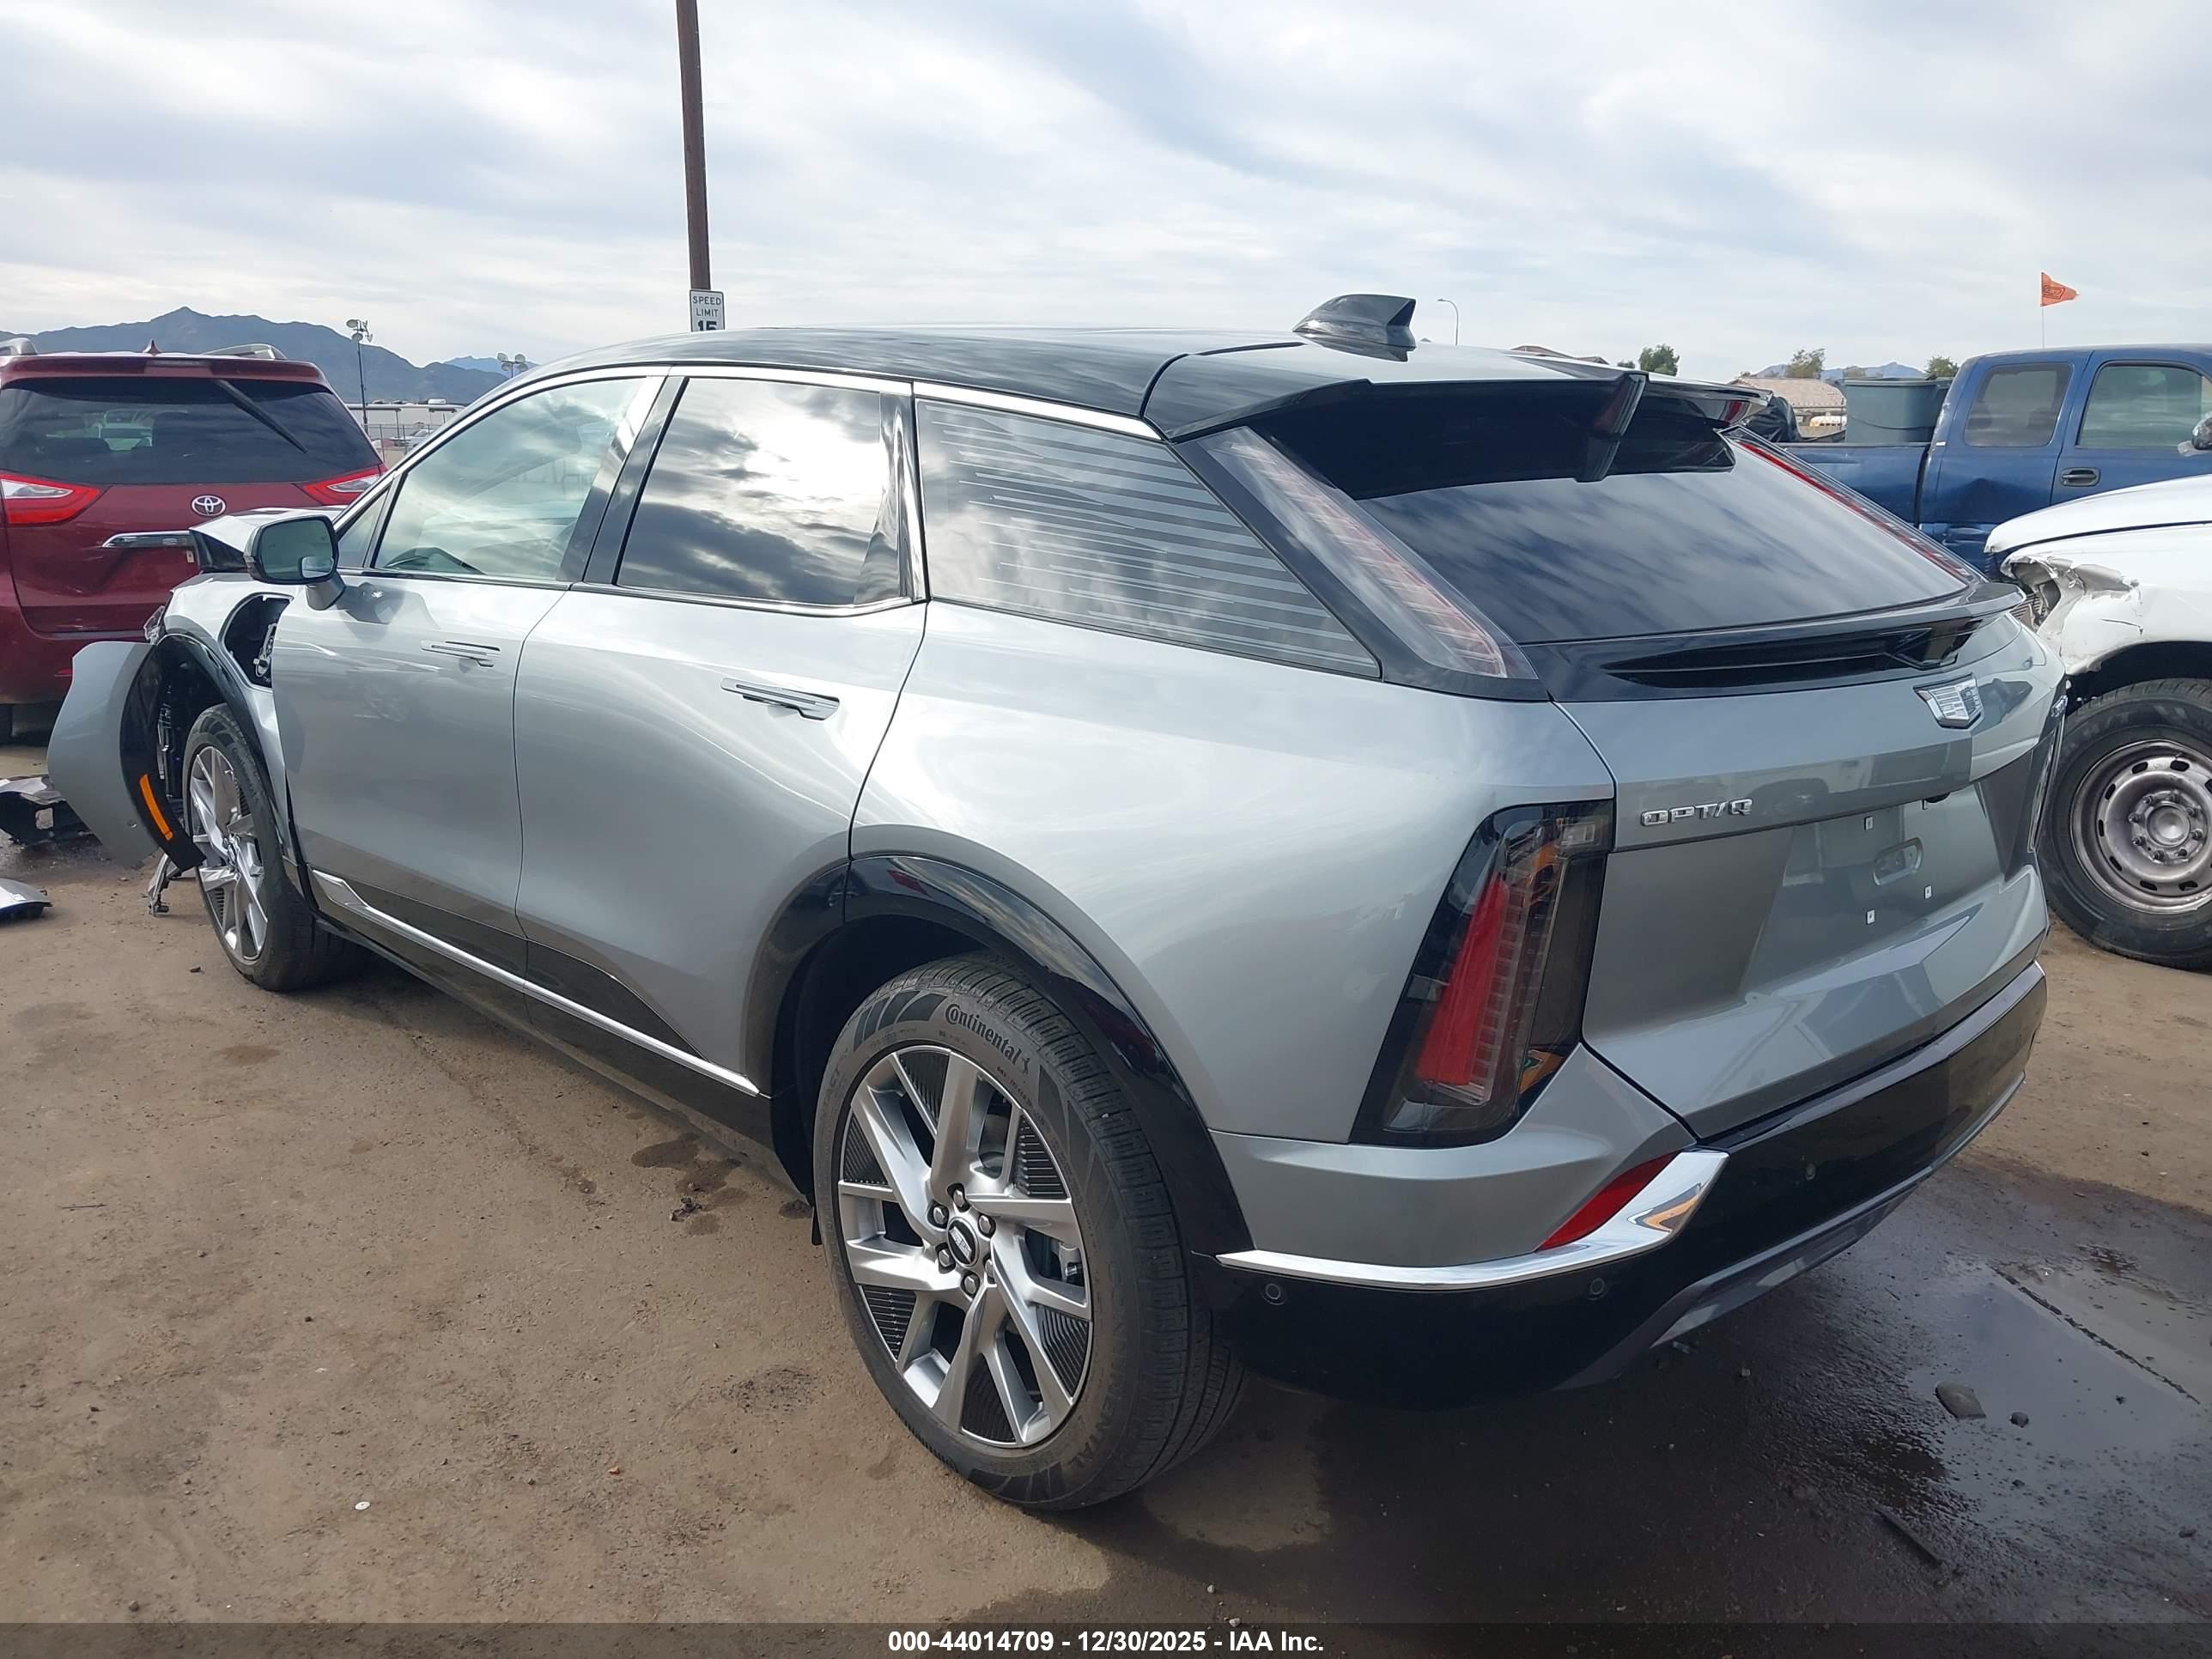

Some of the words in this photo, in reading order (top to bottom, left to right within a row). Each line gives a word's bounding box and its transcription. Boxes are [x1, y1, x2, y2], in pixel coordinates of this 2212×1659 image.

[692, 295, 721, 305] SPEED
[696, 307, 719, 317] LIMIT
[945, 1002, 1023, 1066] Continental
